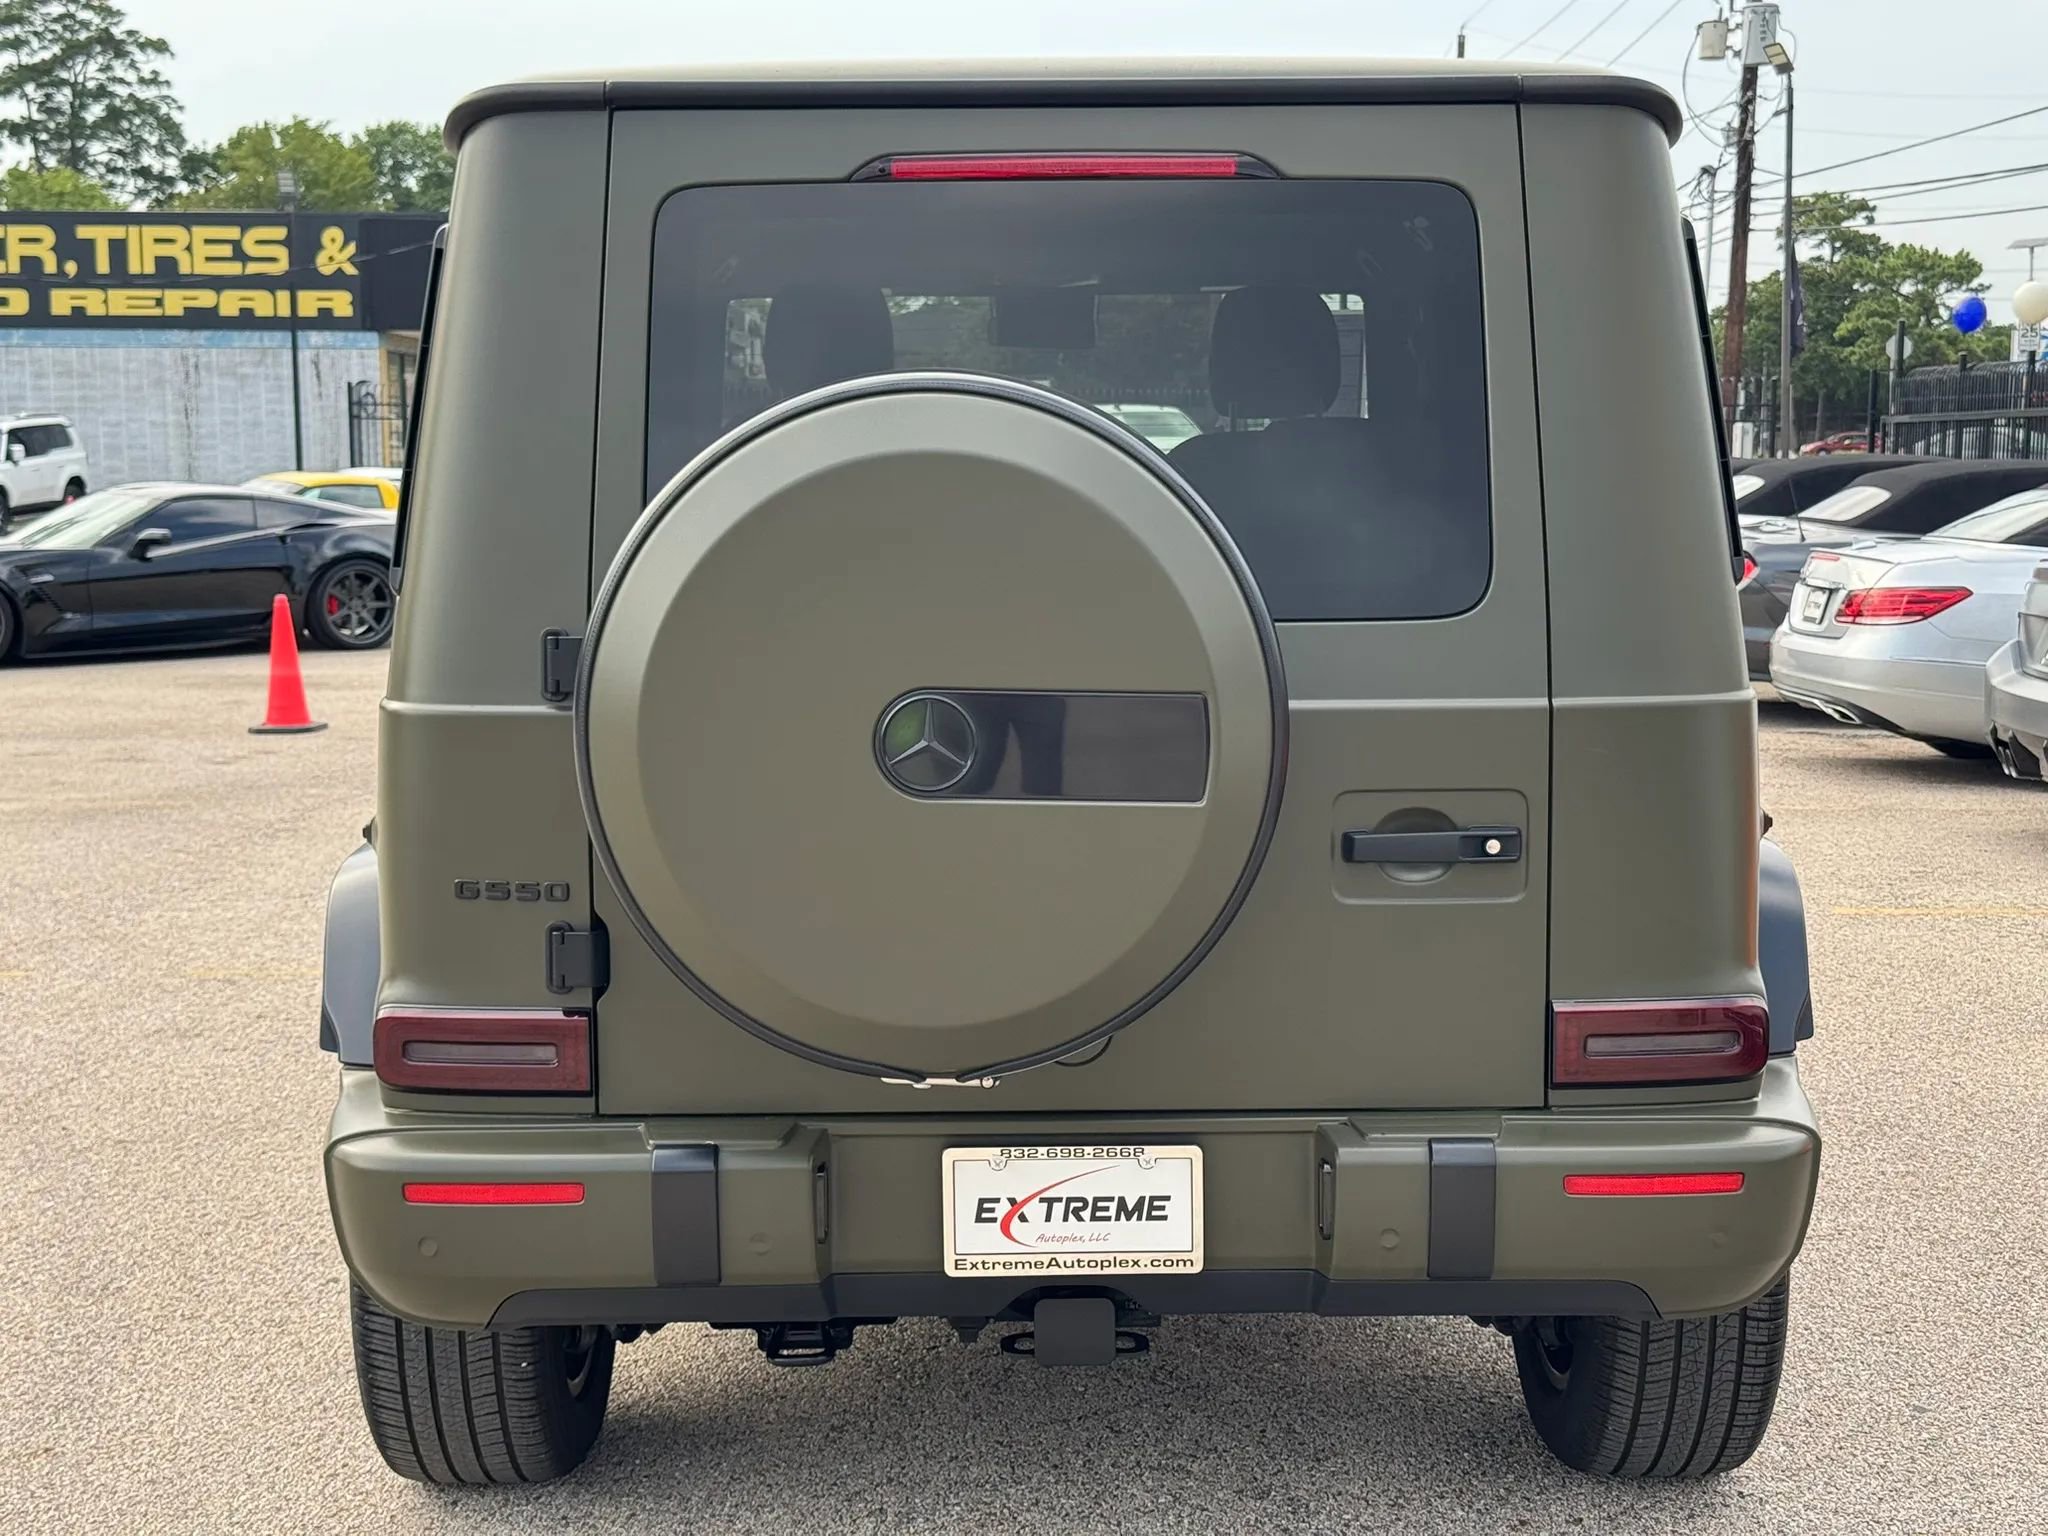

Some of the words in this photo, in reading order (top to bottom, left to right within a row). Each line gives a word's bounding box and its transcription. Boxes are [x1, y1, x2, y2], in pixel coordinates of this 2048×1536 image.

[315, 225, 359, 276] &
[50, 288, 354, 317] REPAIR
[2020, 326, 2039, 338] 25
[454, 878, 570, 902] G550
[1000, 1147, 1145, 1159] 832-698-2668
[974, 1195, 1171, 1223] EXTREME
[1035, 1232, 1086, 1245] Autoplex,
[1088, 1232, 1112, 1243] LLC
[954, 1256, 1194, 1272] ExtremeAutoplex.com
